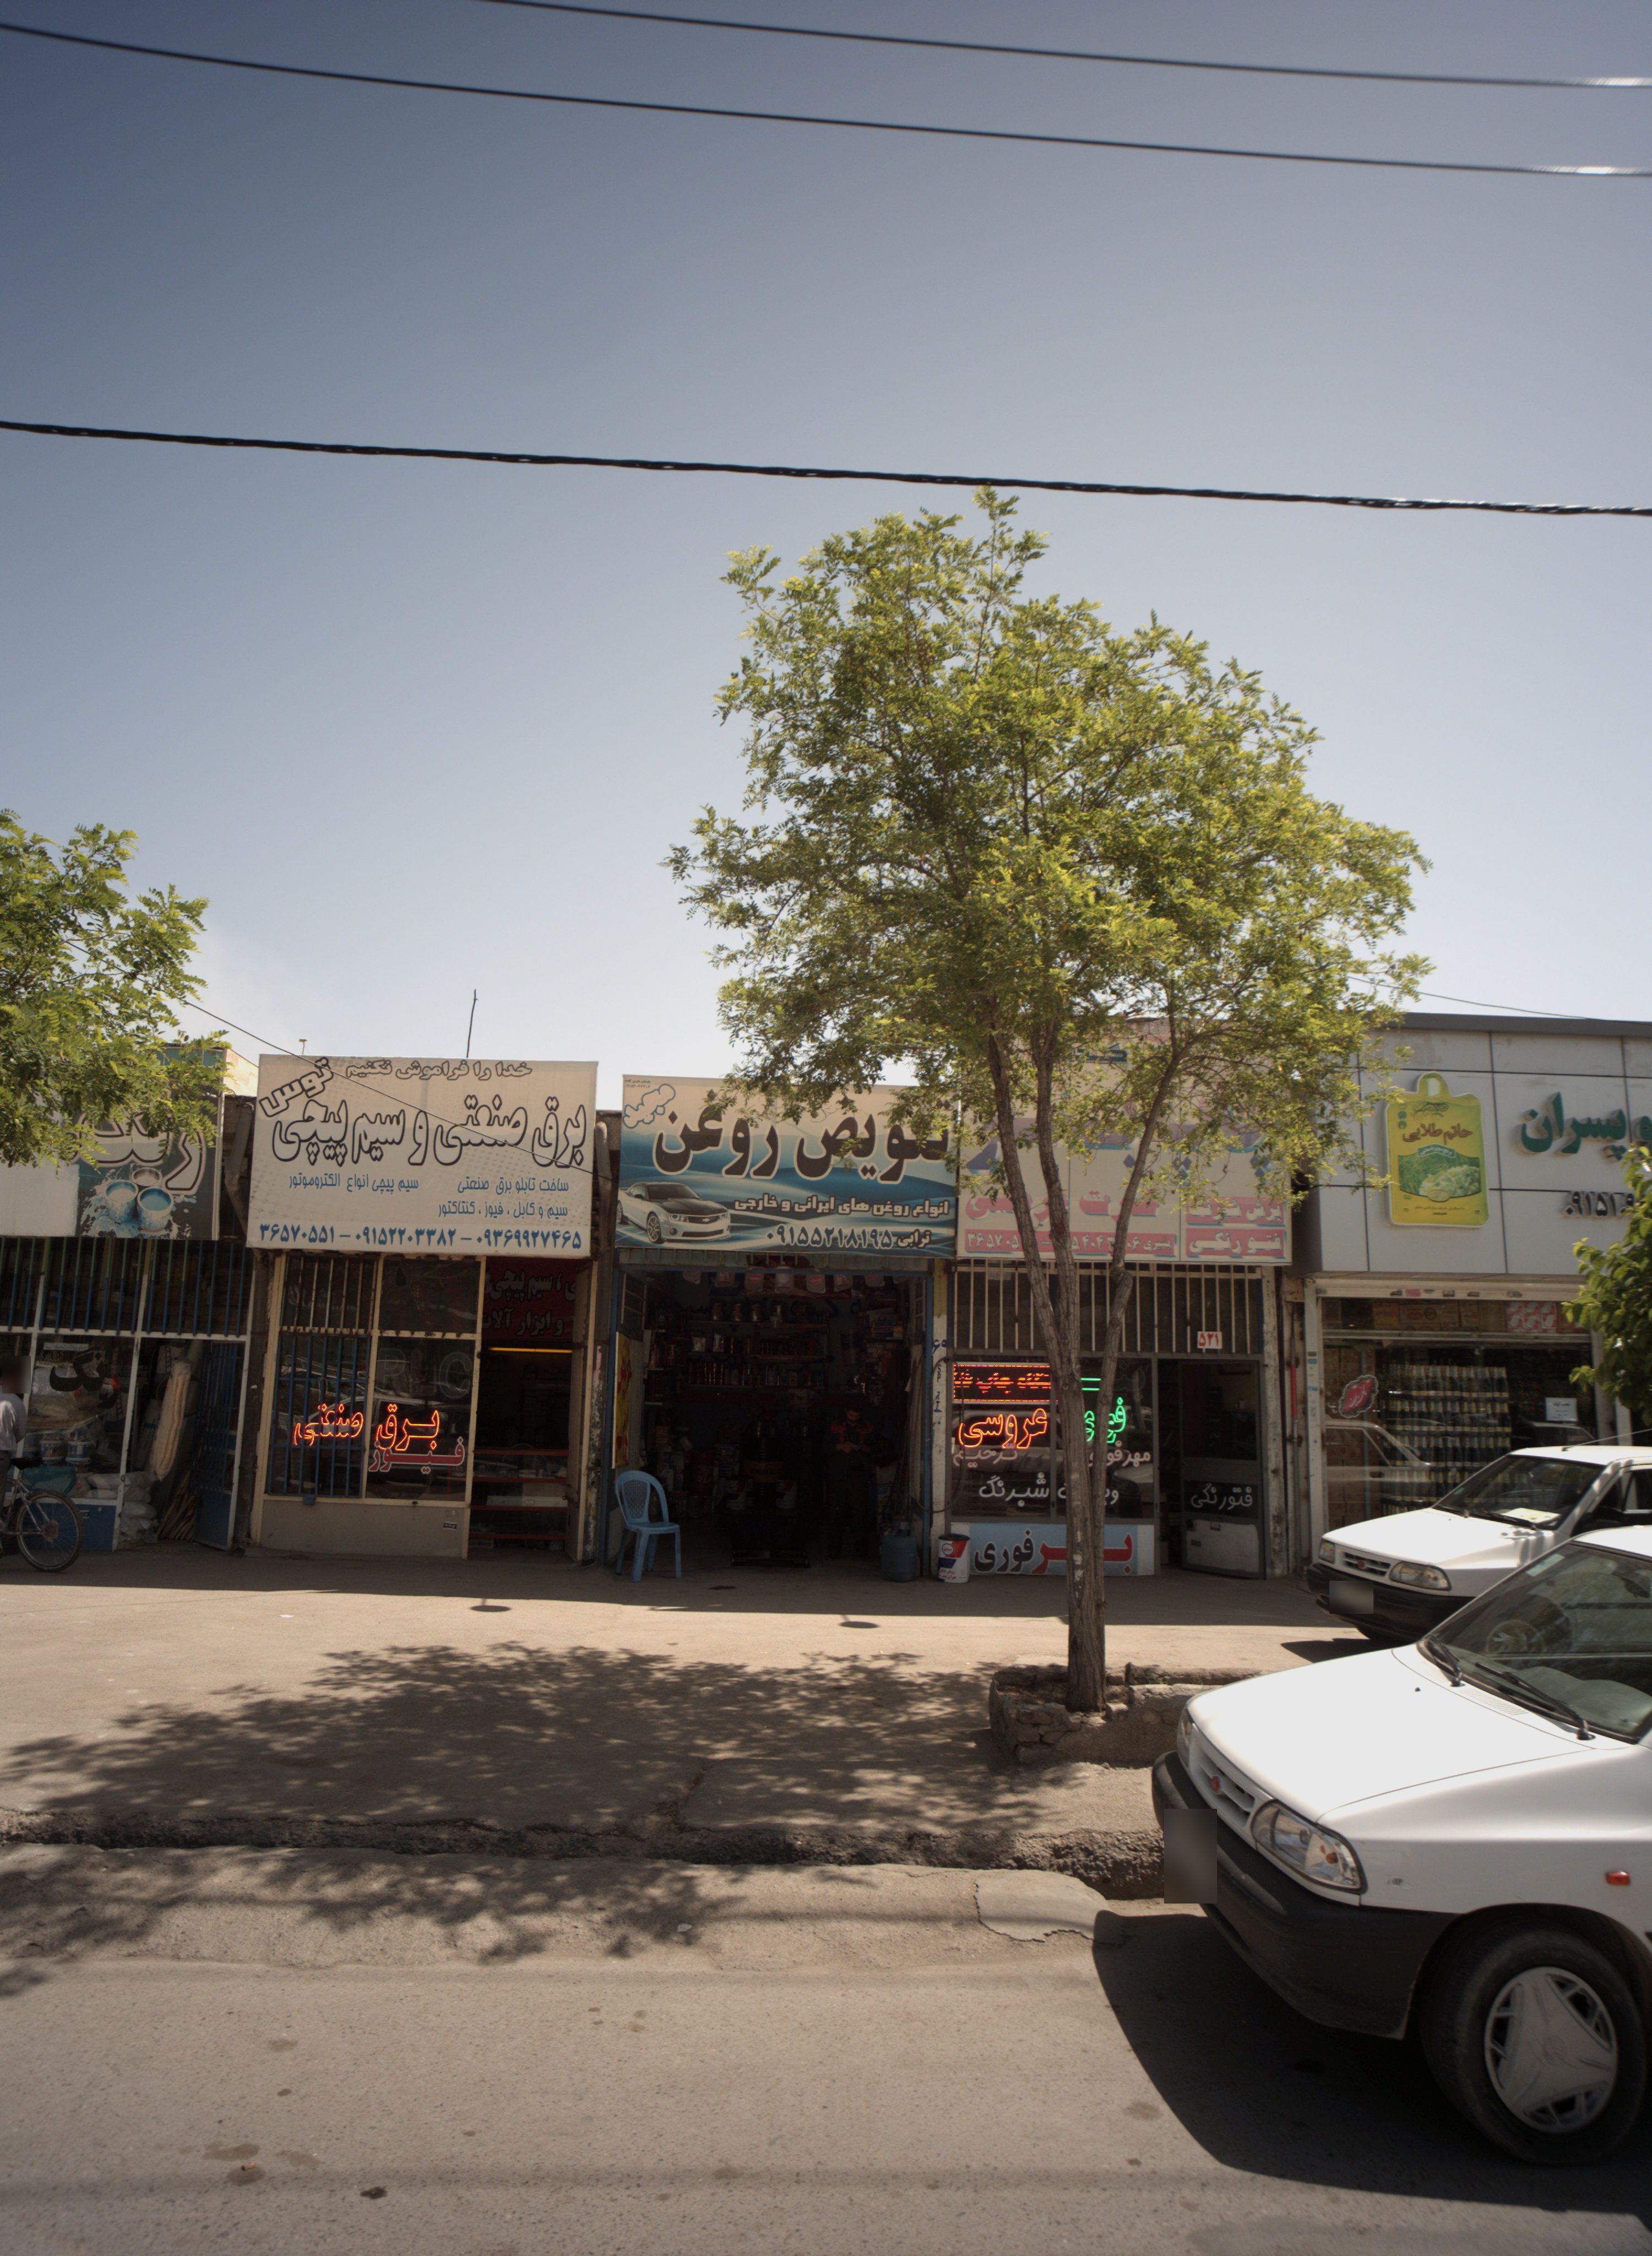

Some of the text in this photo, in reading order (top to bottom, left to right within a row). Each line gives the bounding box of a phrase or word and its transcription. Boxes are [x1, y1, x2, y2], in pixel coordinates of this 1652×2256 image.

[346, 1059, 532, 1081] خدا را فراموش نکنیم
[259, 1057, 334, 1117] توس
[272, 1094, 586, 1168] برق صنعتی و سیم پیچی
[654, 1088, 778, 1178] روغن
[1520, 1092, 1627, 1161] پسران
[796, 1093, 952, 1183] تویض
[289, 1172, 419, 1194] سیم پیچی انواع الکتروموتور
[458, 1176, 569, 1195] ساخت تابلو برق صنعتی
[438, 1201, 475, 1217] کنتاکتور
[485, 1201, 503, 1218] فیوز
[513, 1201, 535, 1218] کابل
[547, 1206, 568, 1219] سیم
[734, 1193, 778, 1211] خارجی
[781, 1199, 791, 1212] و
[794, 1195, 835, 1213] ایرانی
[838, 1197, 870, 1214] های
[872, 1200, 909, 1217] روغن
[912, 1200, 949, 1218] انواع
[538, 1207, 543, 1219] و
[260, 1223, 334, 1243] ۳۶۵۷۰۵۵۱
[355, 1226, 456, 1246] ۰۹۱۵۲۲۰۳۳۸۲
[477, 1228, 582, 1249] ۰۹۳۶۹۹۲۷۴۶۵
[767, 1224, 932, 1249] ترابی ۰۹۱۵۵۲۱۸۱۹۵
[1189, 1230, 1282, 1255] فتو رنگی
[490, 1269, 526, 1303] پیچی
[528, 1275, 553, 1301] سیم
[515, 1308, 552, 1336] ابزار
[553, 1318, 563, 1337] و
[1199, 1333, 1219, 1346] ۵۲۱
[376, 1402, 441, 1452] برق
[958, 1408, 1047, 1449] عروسی
[368, 1436, 466, 1474] فیوز
[979, 1472, 1050, 1507] شبرنگ
[974, 1530, 1133, 1574] بر فوری
